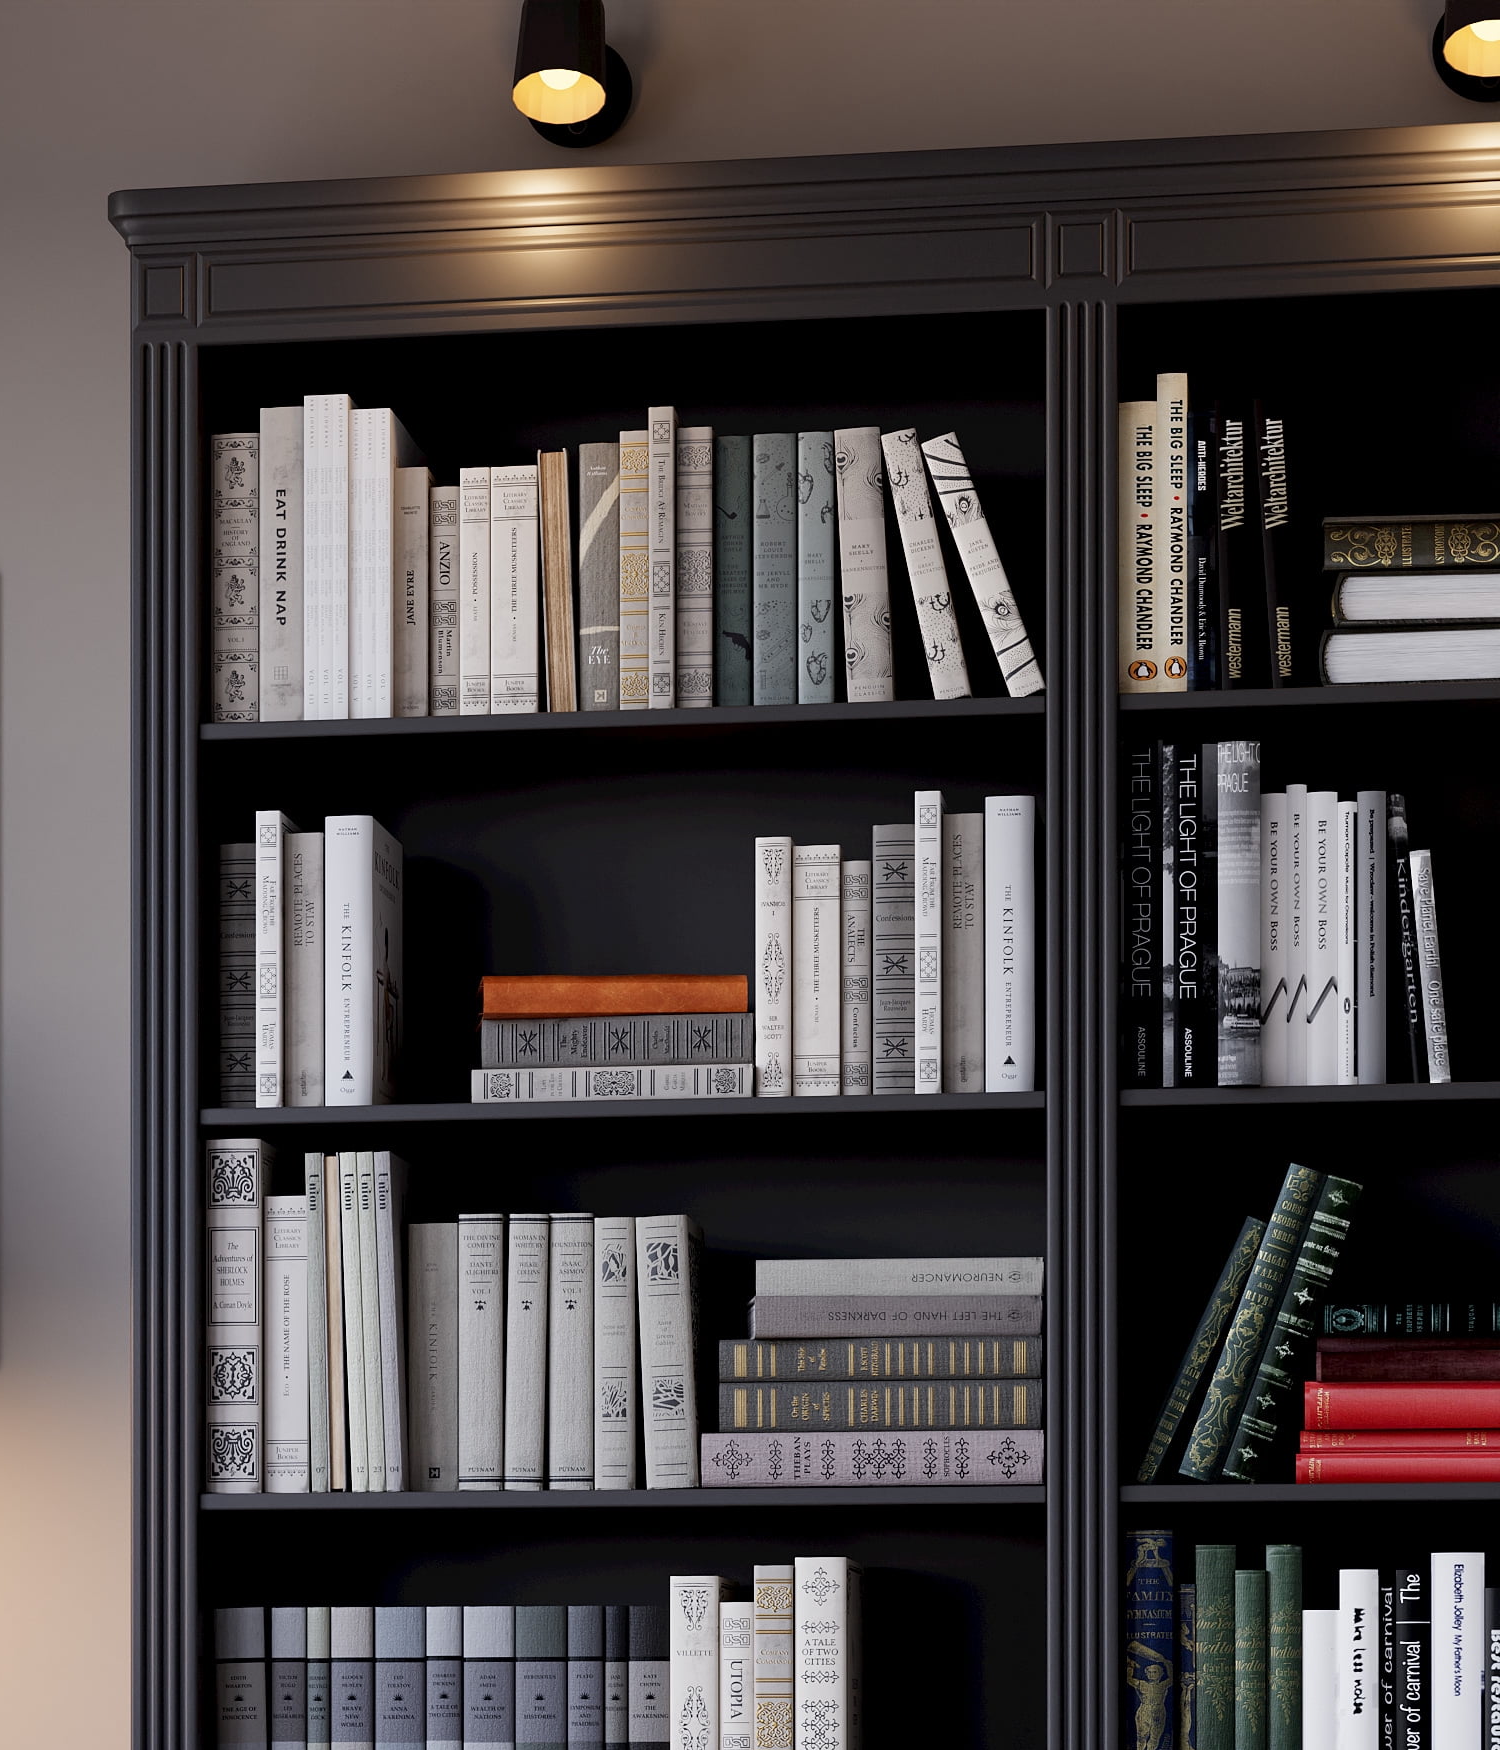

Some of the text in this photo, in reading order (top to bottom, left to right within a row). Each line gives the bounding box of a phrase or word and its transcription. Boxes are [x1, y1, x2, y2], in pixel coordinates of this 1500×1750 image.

[1197, 440, 1207, 491] ANTI-HEROES
[1219, 419, 1245, 531] Weltarchitektur
[1259, 418, 1289, 530] Weltarchitektur
[1135, 425, 1154, 651] THE BIG SLEEP RAYMOND CHANDLER
[1170, 399, 1184, 646] THE BIG SLEEP RAYMOND CHANDLER
[275, 488, 287, 626] EAT DRINK NAP
[439, 541, 451, 586] ANZIO
[406, 569, 416, 626] JANE EYRE
[588, 654, 611, 665] EYE
[591, 645, 609, 655] The
[1225, 608, 1242, 679] westermann
[1275, 606, 1292, 677] westermann
[1003, 884, 1014, 903] THE
[1178, 753, 1197, 1000] THE LIGHT OF PRAGUE
[1270, 821, 1279, 952] BE YOUR OWN BOSS
[1317, 819, 1328, 950] BE YOUR OWN BOSS
[291, 853, 303, 947] REMOTE PLACES
[304, 899, 315, 947] TO STAY
[847, 914, 856, 963] ANALECTS
[856, 926, 867, 948] THE
[1002, 908, 1014, 975] KINFOLK
[1395, 856, 1420, 1024] Kindergarten
[341, 925, 352, 992] KINFOLK
[343, 998, 351, 1061] ENTREPRENEUR
[852, 1007, 860, 1048] Confucius
[1184, 1027, 1193, 1078] ASSOULINE
[309, 1173, 320, 1211] Union
[343, 1173, 355, 1211] Union
[360, 1172, 372, 1210] Union
[378, 1172, 390, 1210] Union
[213, 1253, 254, 1263] Adventures of
[227, 1241, 239, 1251] The
[215, 1265, 248, 1275] SHERLOCK
[219, 1277, 245, 1287] HOLMES
[911, 1272, 1003, 1283] NEUROMANCER
[283, 1315, 290, 1327] OF
[827, 1310, 1004, 1321] THE LEFT HAND OF DARKNESS
[793, 1436, 801, 1481] THEBAN
[803, 1441, 811, 1474] PLAYS
[943, 1435, 951, 1478] SOPHOCLES
[1452, 1563, 1465, 1631] Elizabeth Jolley
[676, 1649, 714, 1657] VILLETTE
[801, 1648, 839, 1656] OF TWO
[804, 1638, 837, 1647] A TALE
[804, 1657, 836, 1666] CITIES
[1399, 1640, 1421, 1701] carnival
[1452, 1634, 1463, 1697] My Father's Moon
[730, 1660, 743, 1720] UTOPIA
[1399, 1703, 1421, 1723] of
